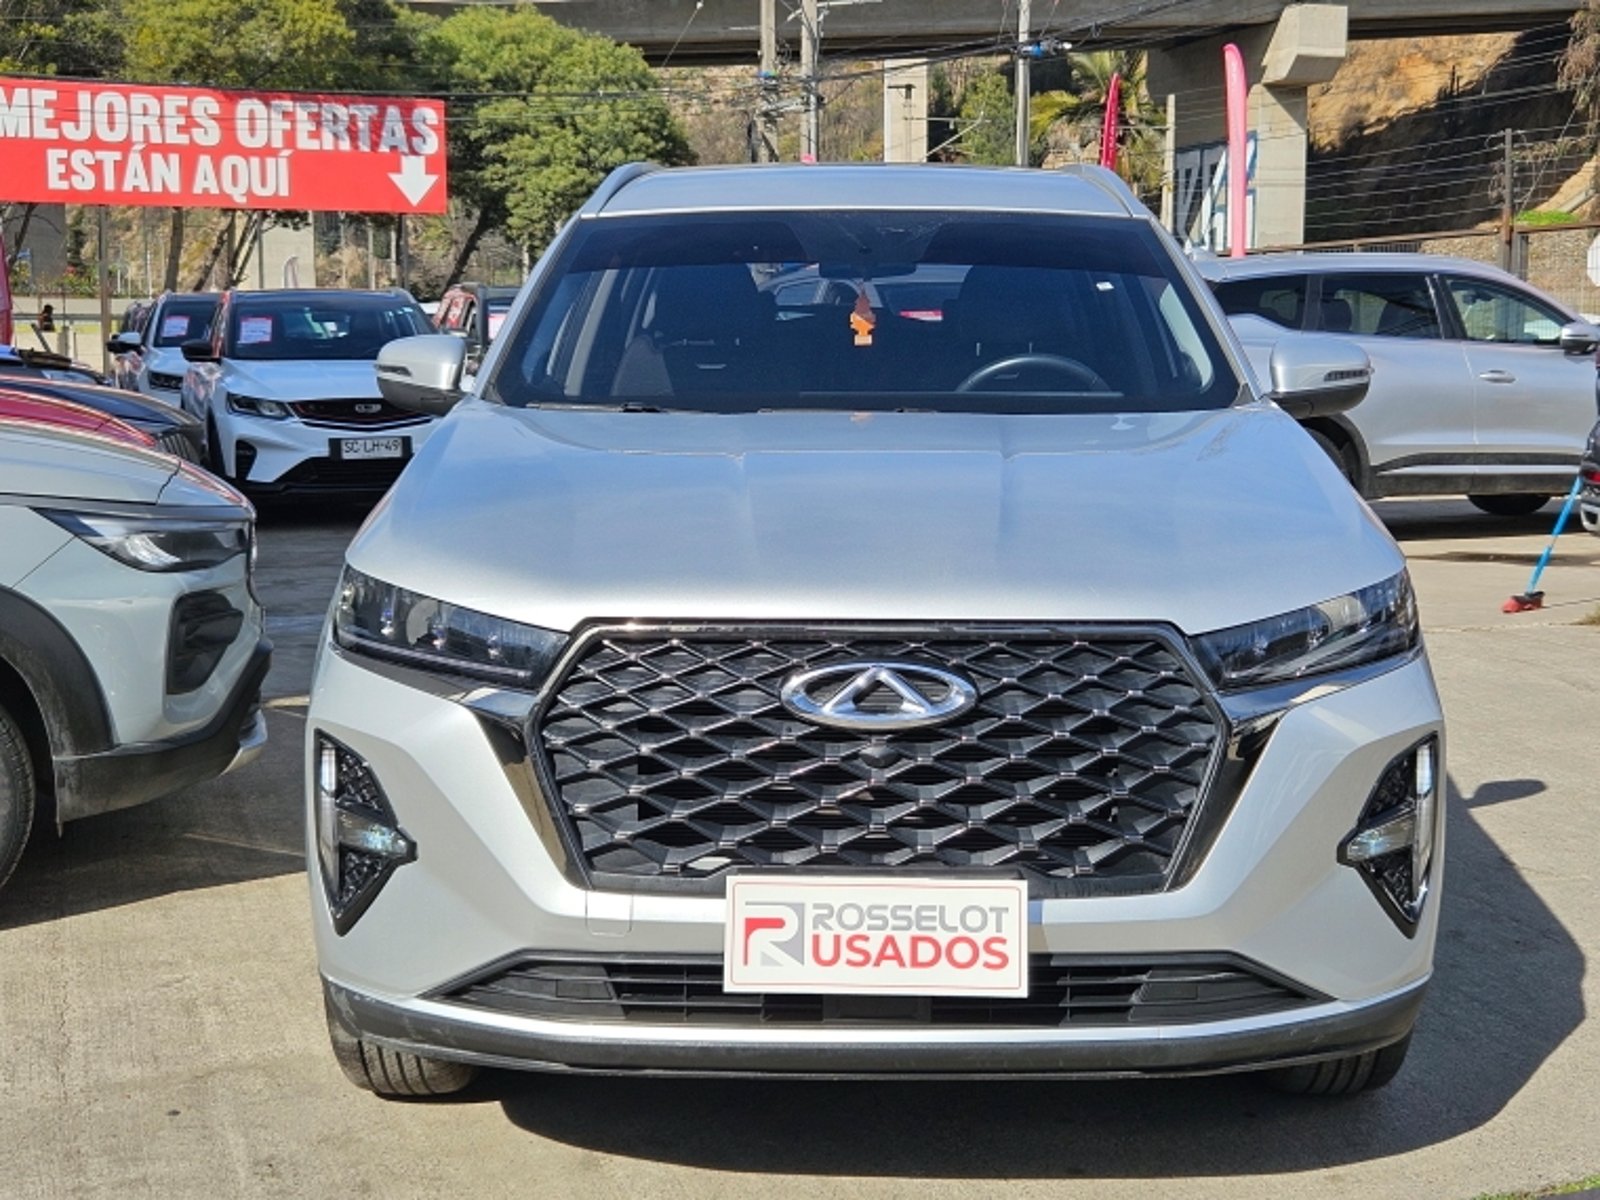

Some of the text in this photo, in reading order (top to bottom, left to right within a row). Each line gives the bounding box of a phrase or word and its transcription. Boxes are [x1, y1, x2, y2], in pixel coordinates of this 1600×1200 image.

[0, 87, 440, 155] MEJORES OFERTAS
[46, 142, 295, 203] ESTÁN AQUÍ
[811, 902, 1010, 933] ROSSELOT
[811, 934, 1010, 970] USADOS
